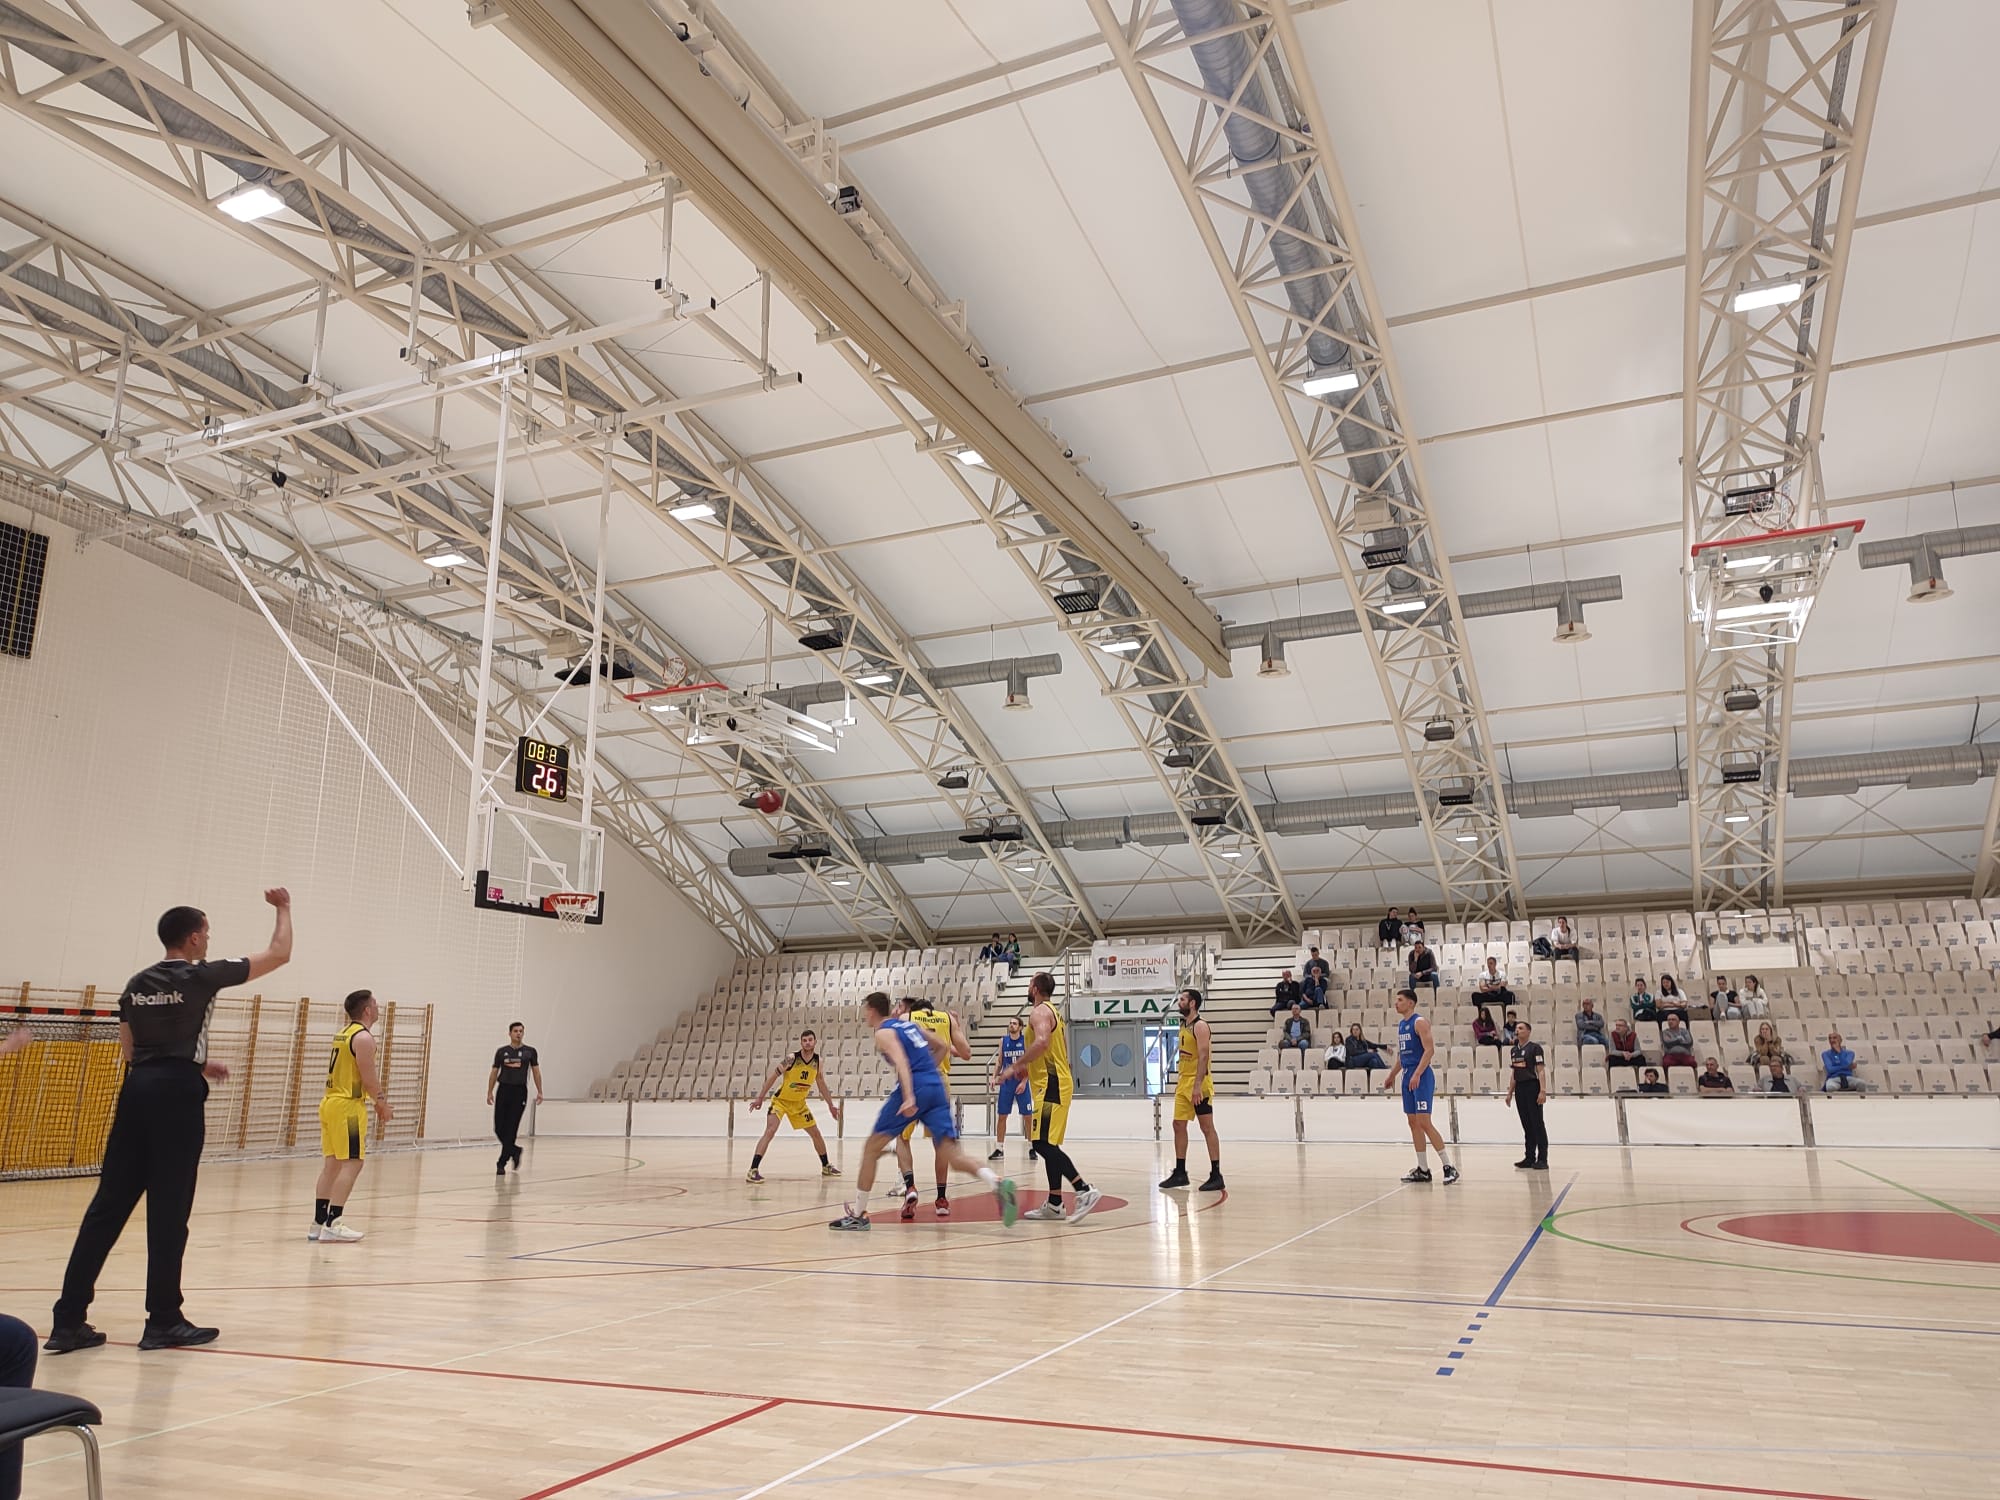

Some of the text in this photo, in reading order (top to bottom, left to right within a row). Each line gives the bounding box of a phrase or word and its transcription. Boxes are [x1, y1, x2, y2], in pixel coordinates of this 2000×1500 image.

[532, 764, 558, 793] 26
[1120, 957, 1169, 967] FORTUNA
[1121, 967, 1160, 975] DIGITAL
[130, 990, 185, 1006] Yealink
[1094, 998, 1180, 1015] IZLAZ
[800, 1070, 809, 1081] 30
[1416, 1101, 1428, 1111] 13
